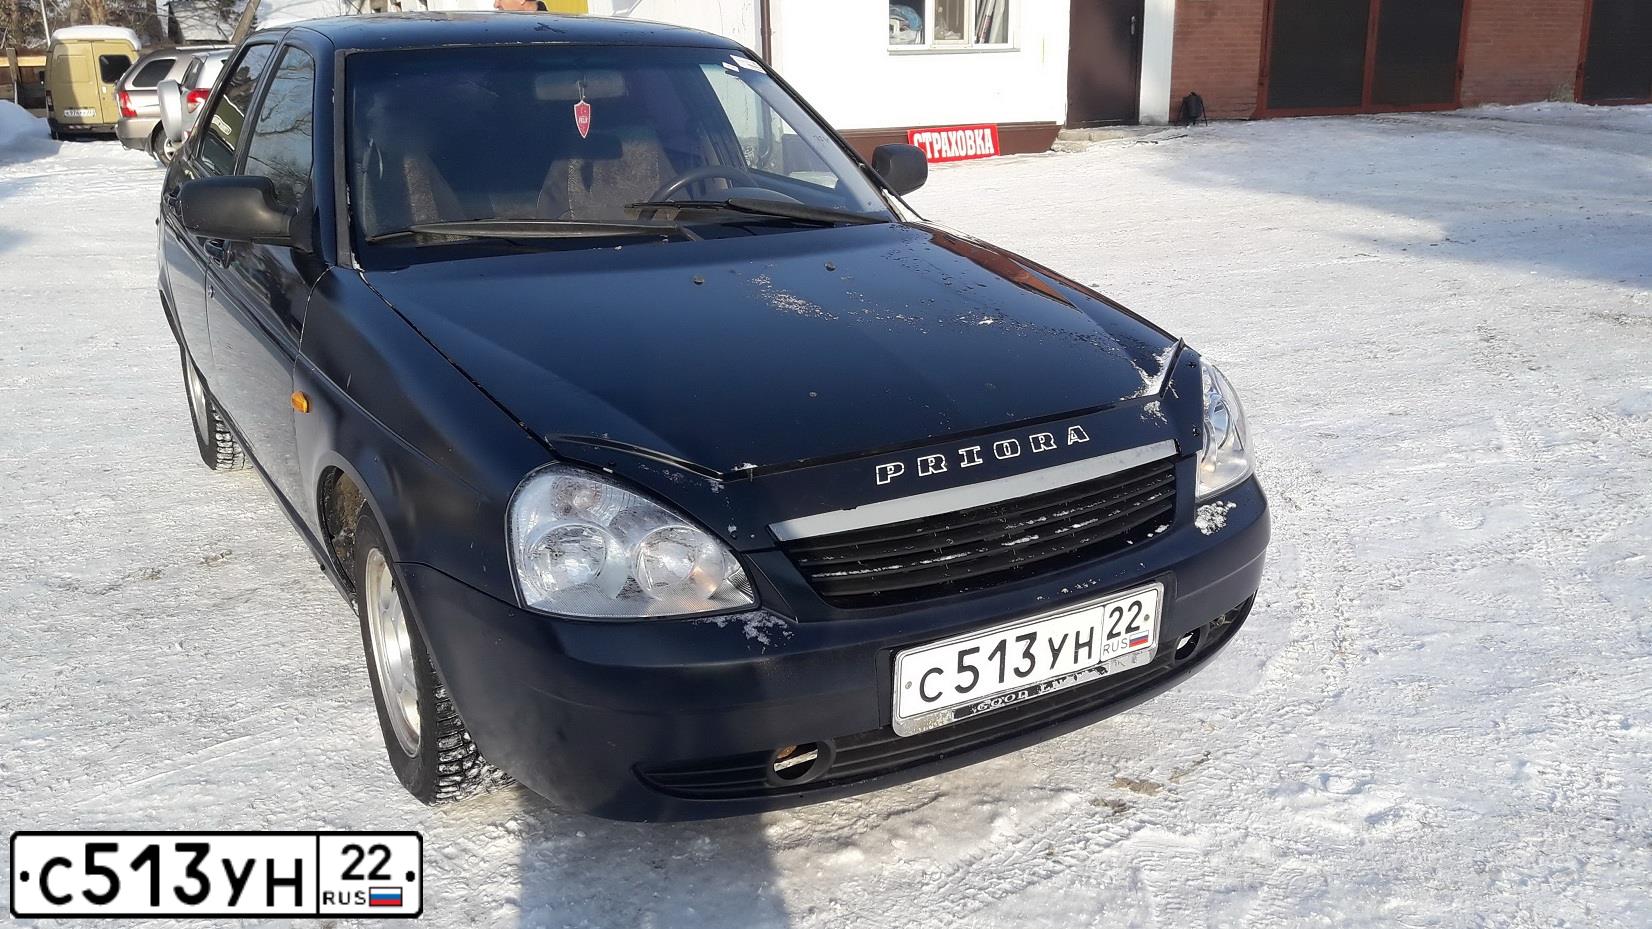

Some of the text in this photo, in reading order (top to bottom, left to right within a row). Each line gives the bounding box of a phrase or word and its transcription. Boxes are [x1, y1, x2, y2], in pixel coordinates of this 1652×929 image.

[876, 425, 1090, 485] PRIORA
[918, 626, 1094, 702] С513УН
[1106, 600, 1142, 641] 22
[1103, 638, 1128, 656] RUS
